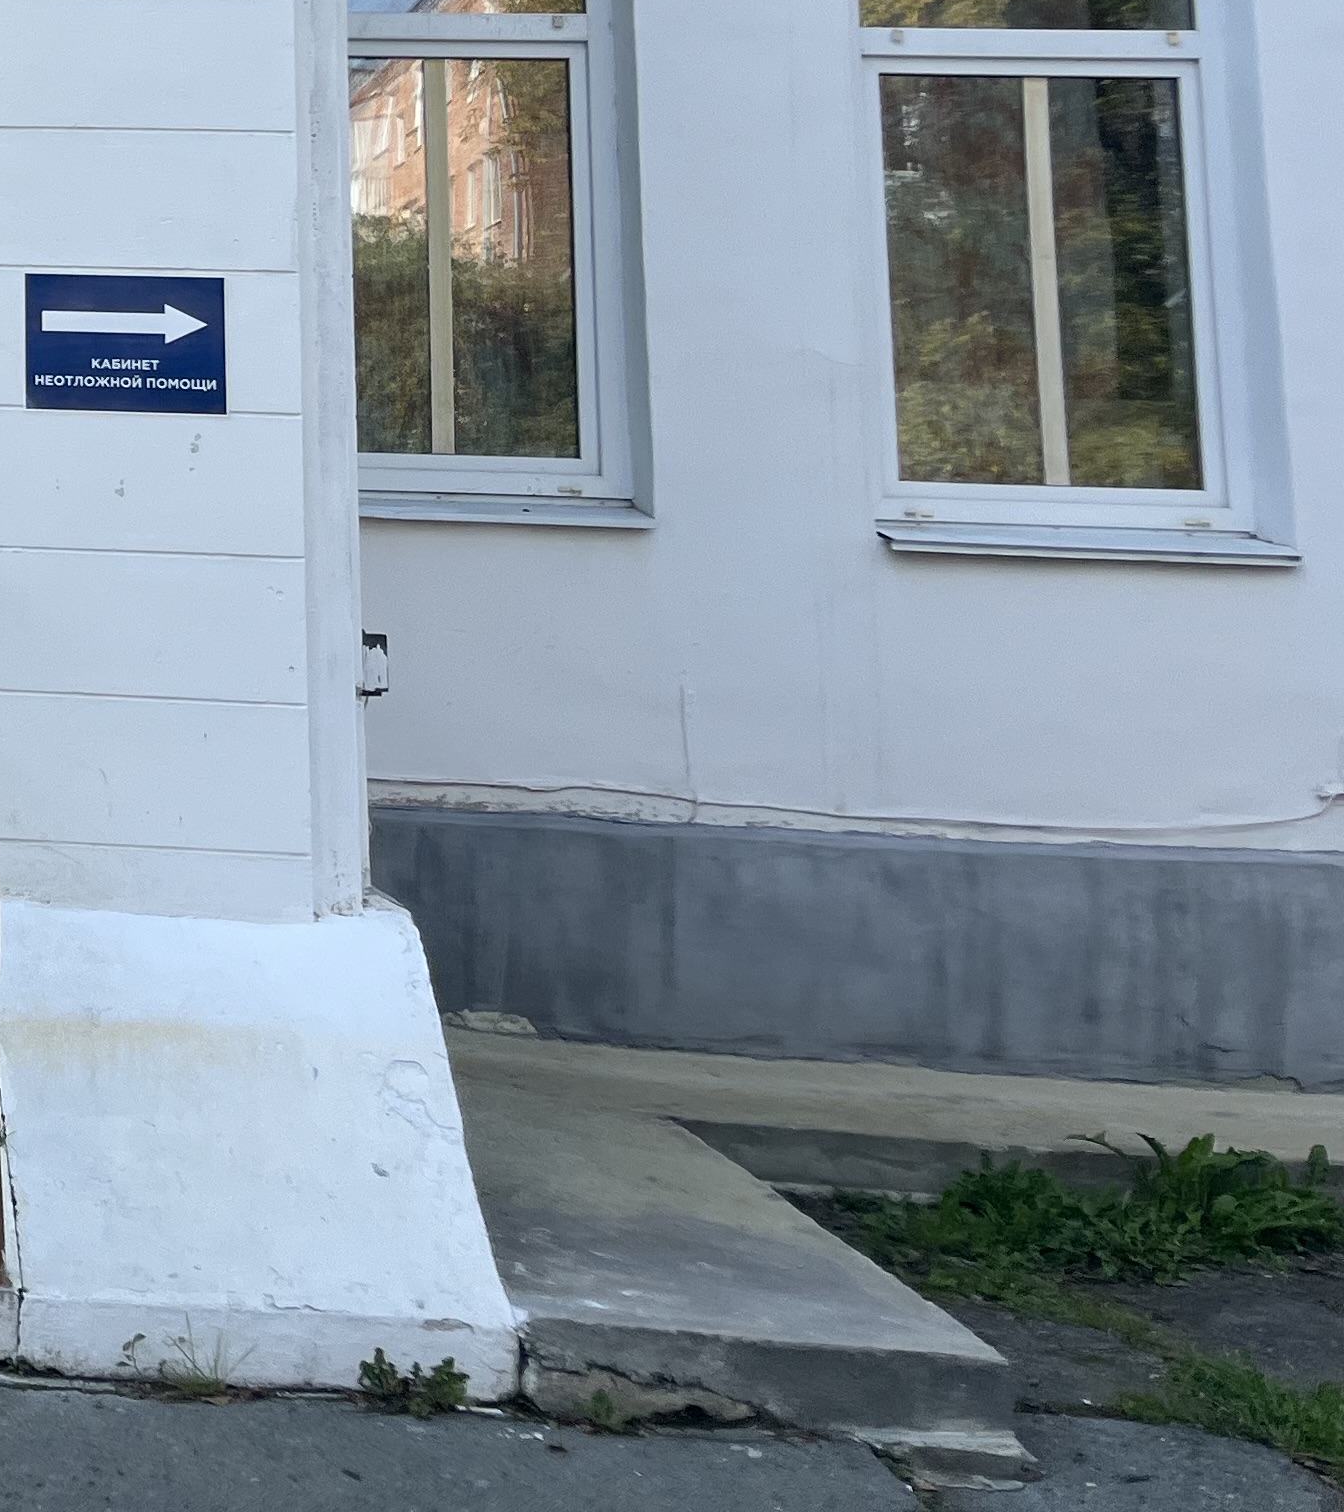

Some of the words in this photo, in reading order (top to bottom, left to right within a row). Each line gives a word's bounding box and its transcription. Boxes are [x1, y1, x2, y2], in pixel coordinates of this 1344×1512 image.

[91, 358, 160, 371] КАБИНЕТ
[34, 374, 143, 389] НЕОТЛОЖНОЙ
[146, 377, 218, 392] ПОМОЩИ
